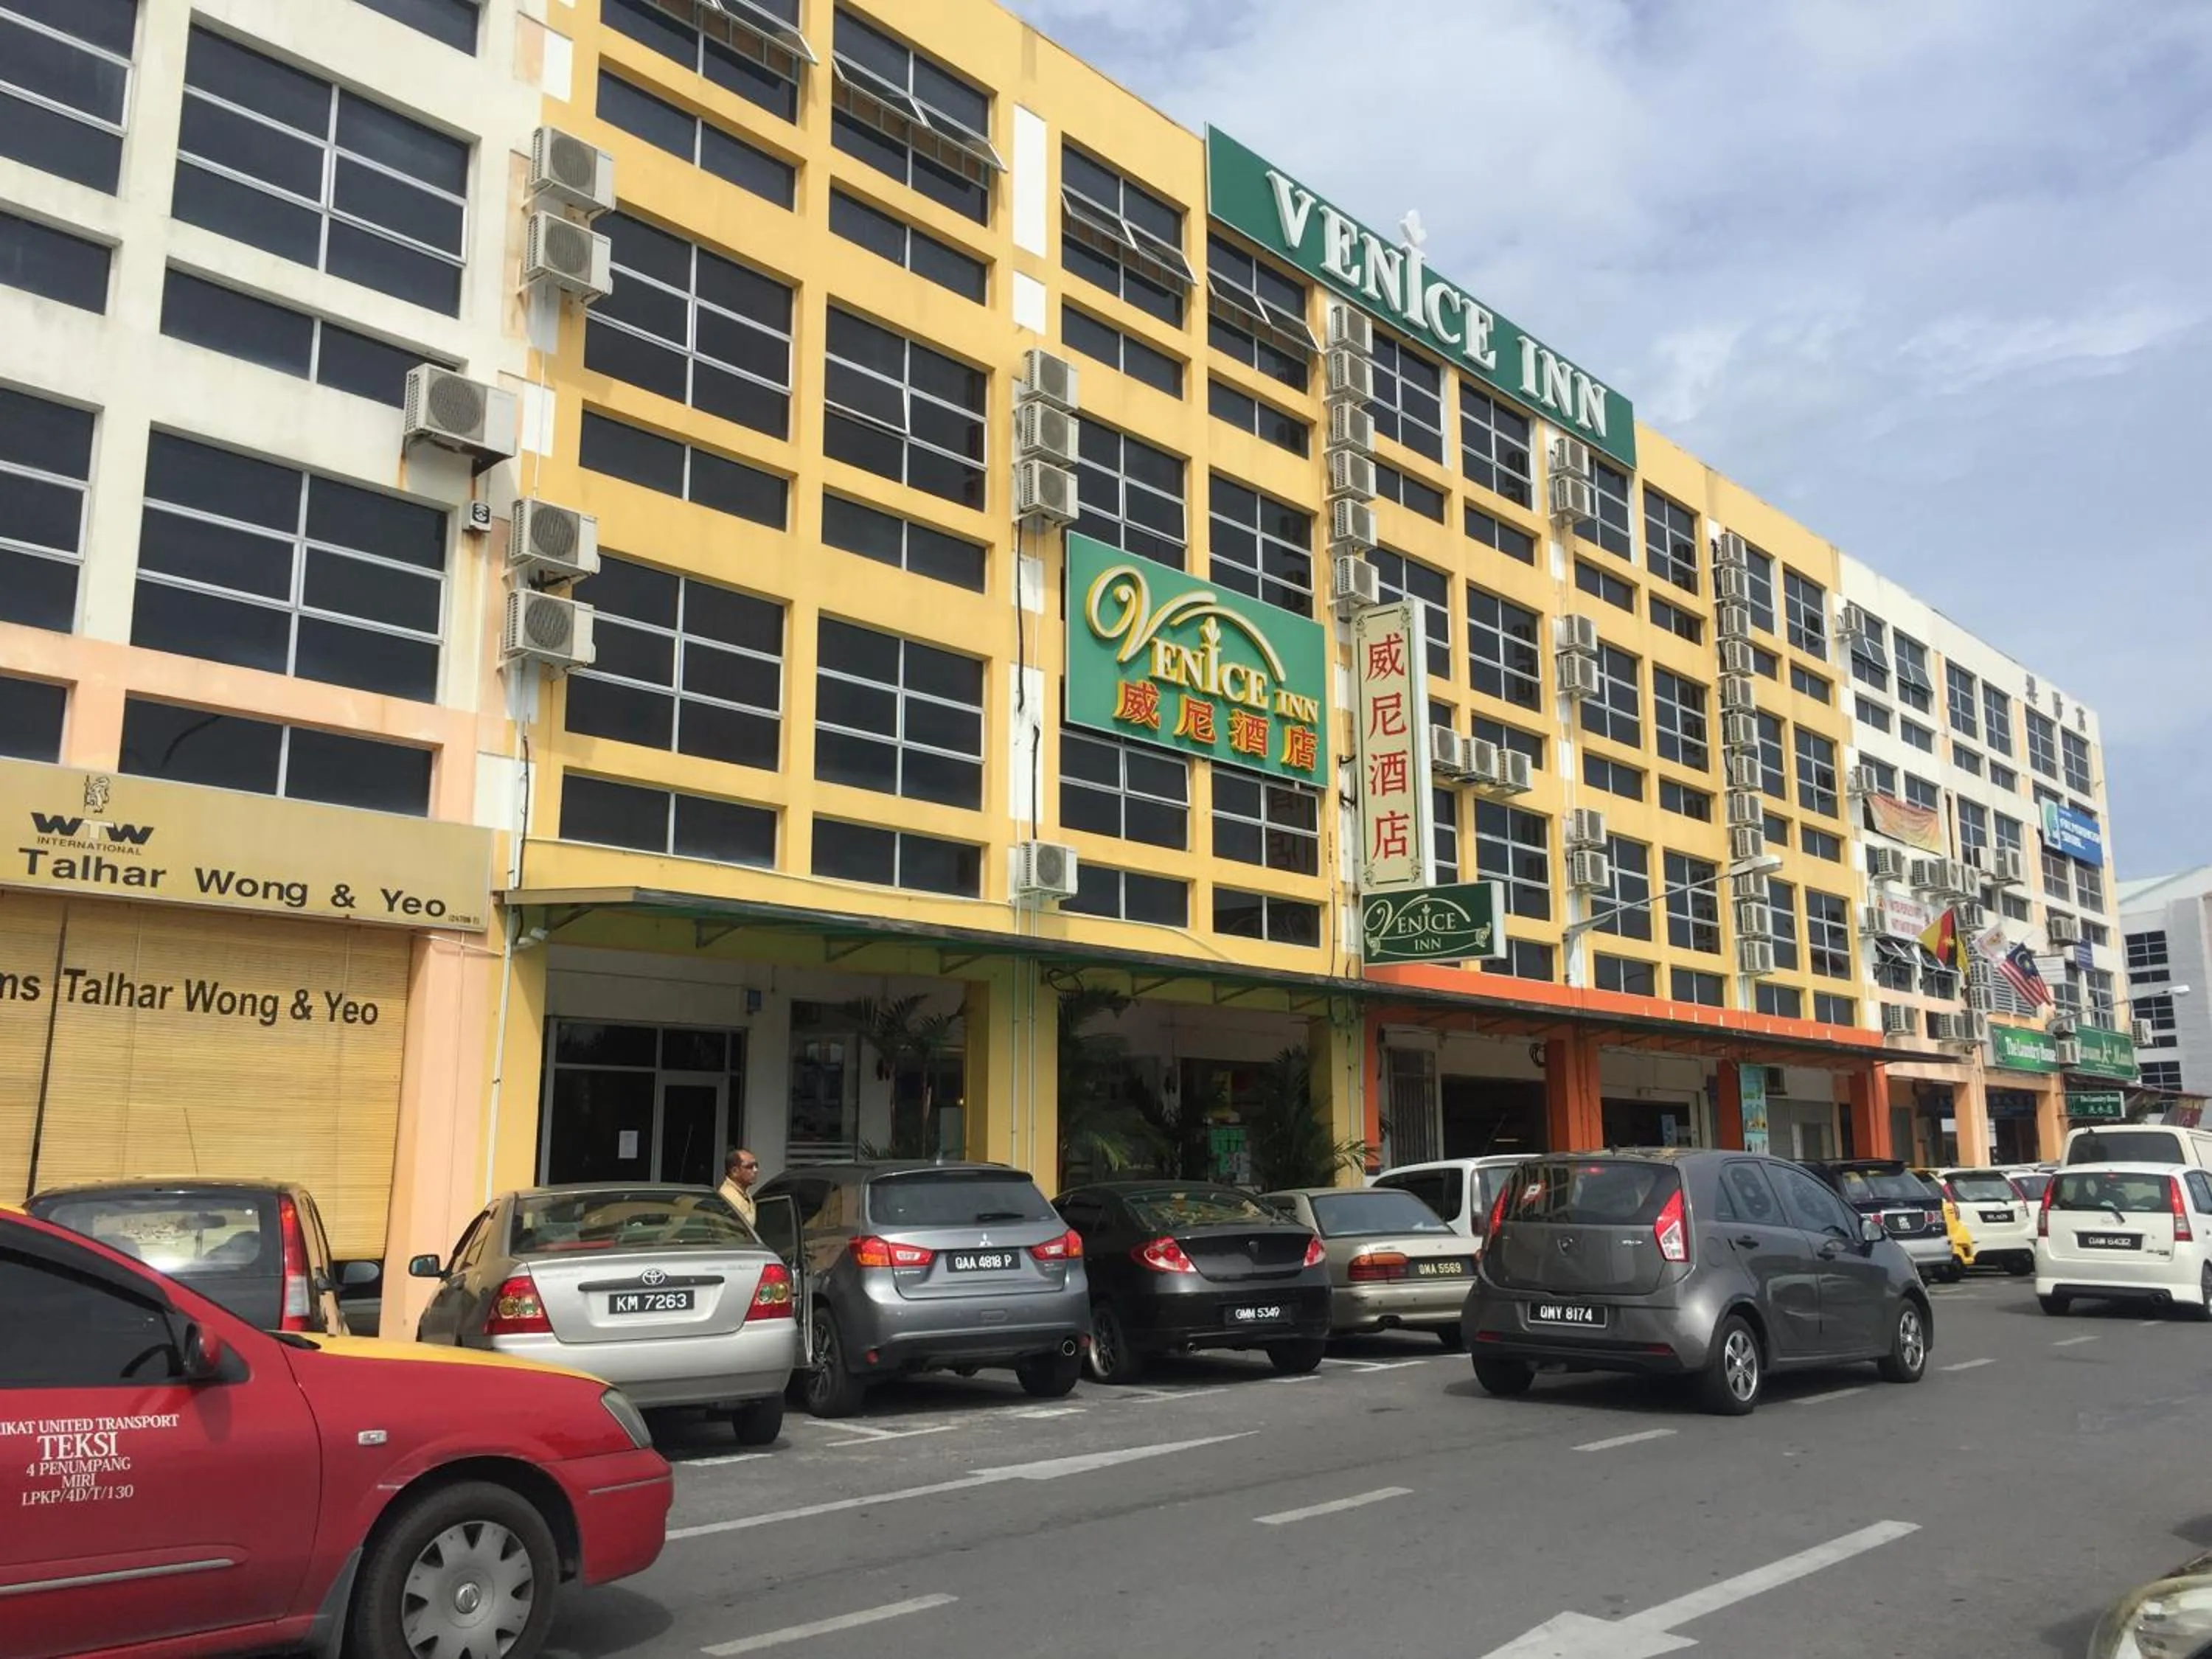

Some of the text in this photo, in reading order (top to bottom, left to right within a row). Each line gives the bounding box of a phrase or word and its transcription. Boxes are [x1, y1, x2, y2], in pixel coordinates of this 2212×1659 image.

[1265, 170, 1607, 438] VENICE INN
[1085, 565, 1320, 724] VENICE INN
[1113, 680, 1318, 772] 威尼酒店
[1366, 633, 1410, 860] 威尼酒店
[30, 812, 154, 845] WTW
[37, 835, 142, 856] INTERNATIONAL
[18, 847, 446, 917] Talhar Wong & Yeo
[1363, 894, 1457, 938] VENICE
[1414, 937, 1441, 950] INN
[63, 968, 173, 1010] Talhar
[184, 978, 279, 1026] Wong
[290, 989, 313, 1020] &
[324, 991, 379, 1026] Yeo
[956, 1254, 1012, 1270] QAA 4818 P
[1439, 1262, 1462, 1273] 5569
[616, 1293, 686, 1312] KM 7263
[1256, 1306, 1281, 1318] 5349
[1565, 1307, 1593, 1322] 8174
[38, 1418, 94, 1433] UNITED
[96, 1414, 179, 1431] TRANSPORT
[37, 1432, 119, 1461] TEKSI
[26, 1457, 131, 1477] 4 PENUMPANG
[61, 1473, 96, 1488] MIRI
[21, 1485, 134, 1506] LPKP/4D/T/130
